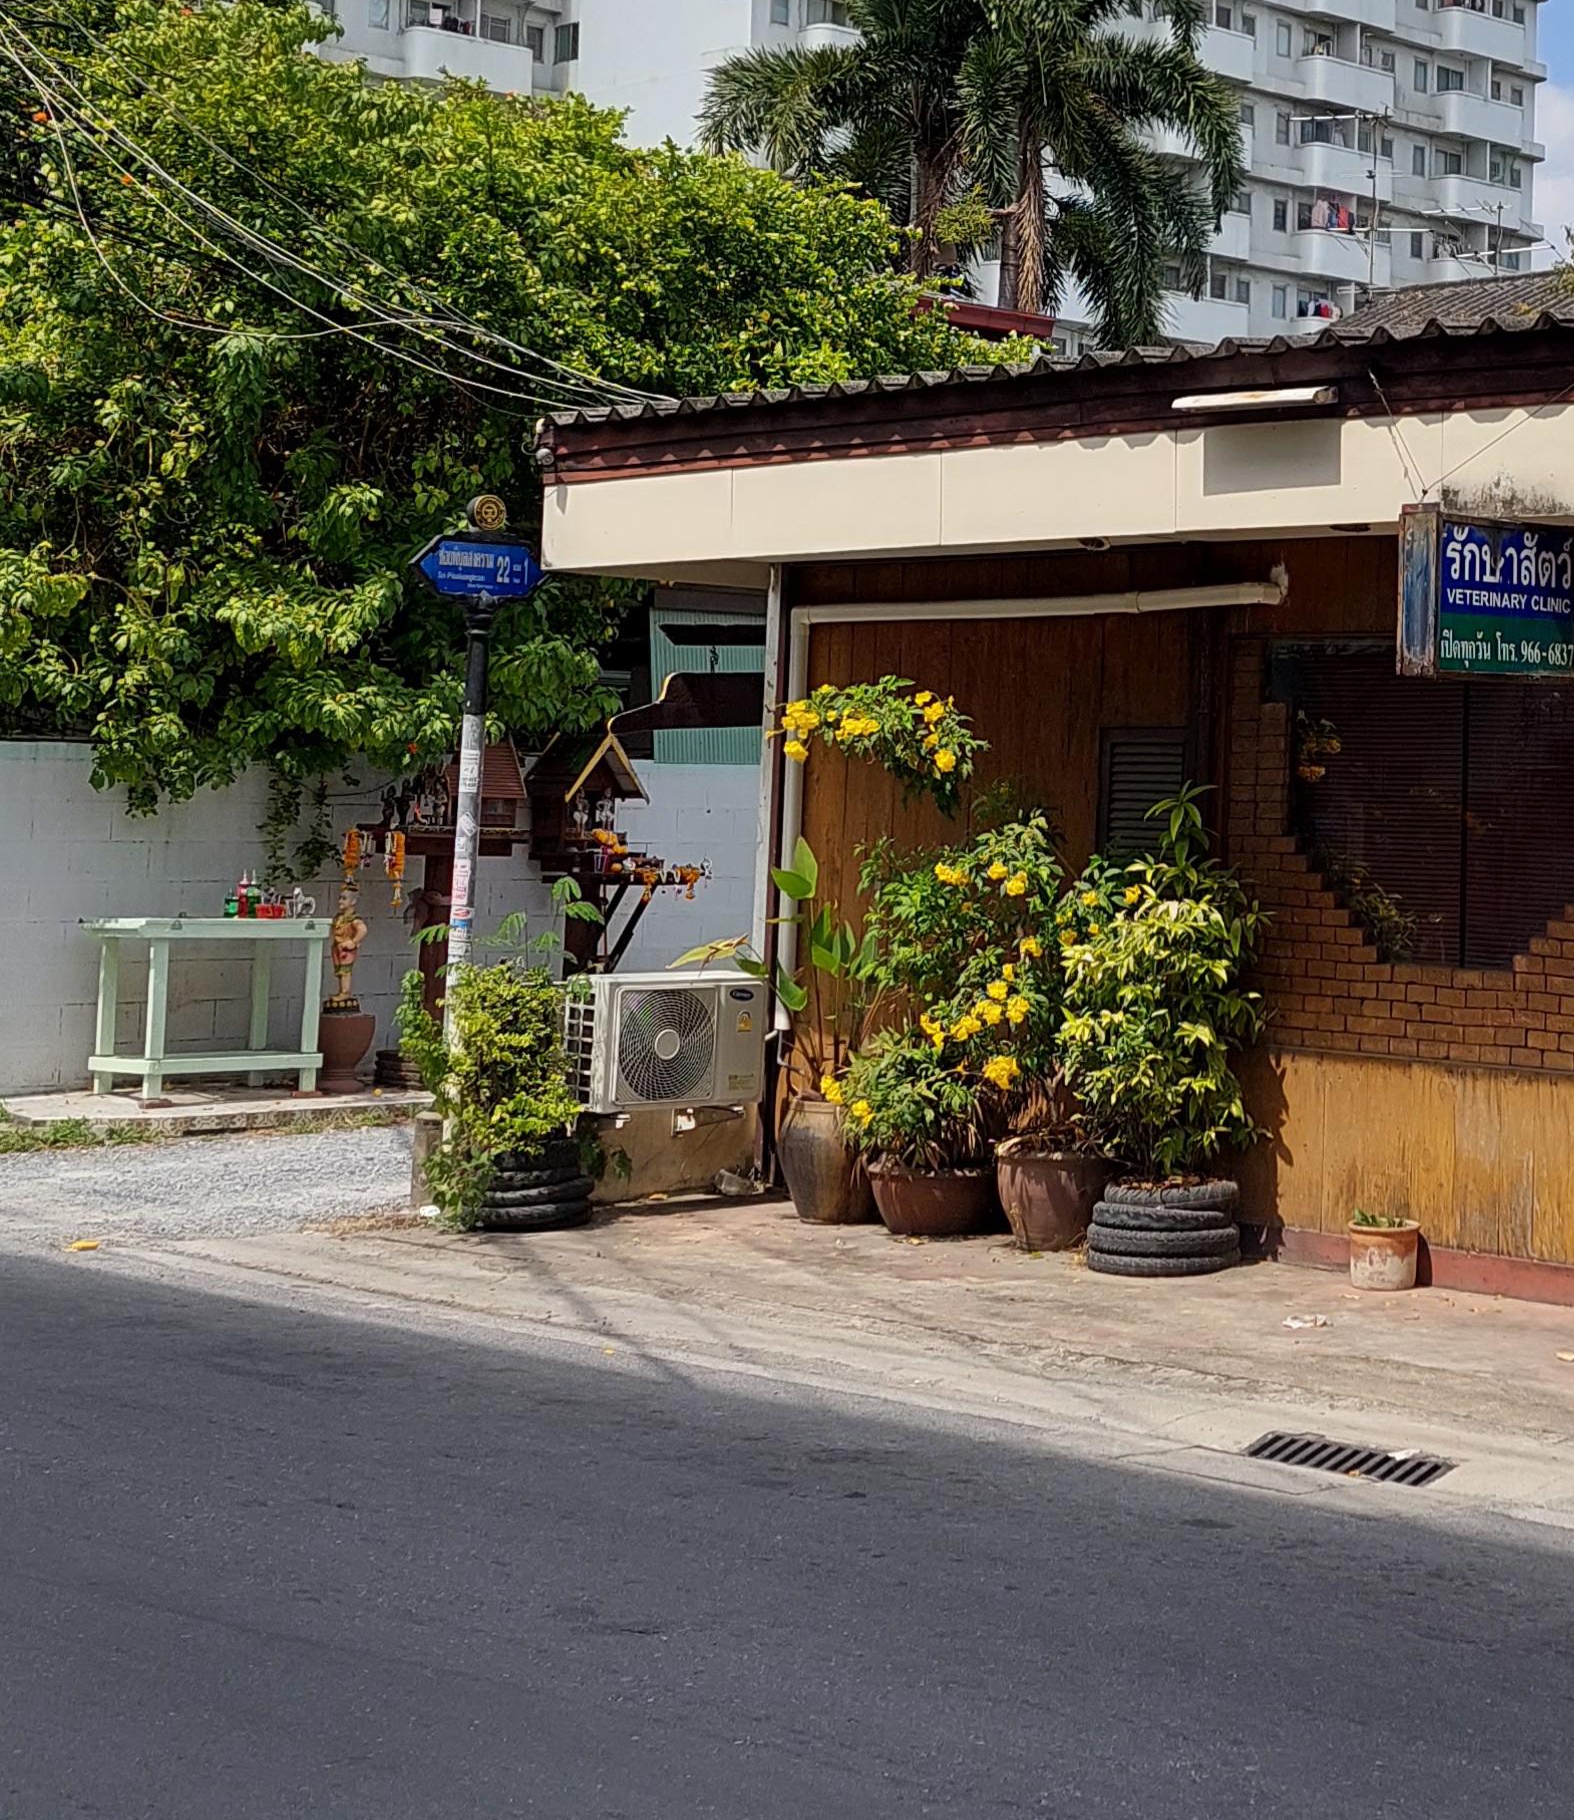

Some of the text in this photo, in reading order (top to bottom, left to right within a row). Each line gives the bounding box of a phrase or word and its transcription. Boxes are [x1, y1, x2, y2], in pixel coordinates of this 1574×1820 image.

[497, 555, 511, 584] 22
[1446, 588, 1571, 614] VETERINARY CLINIC
[1440, 628, 1574, 668] เปิดทุกวัน โทร. 966-6837
